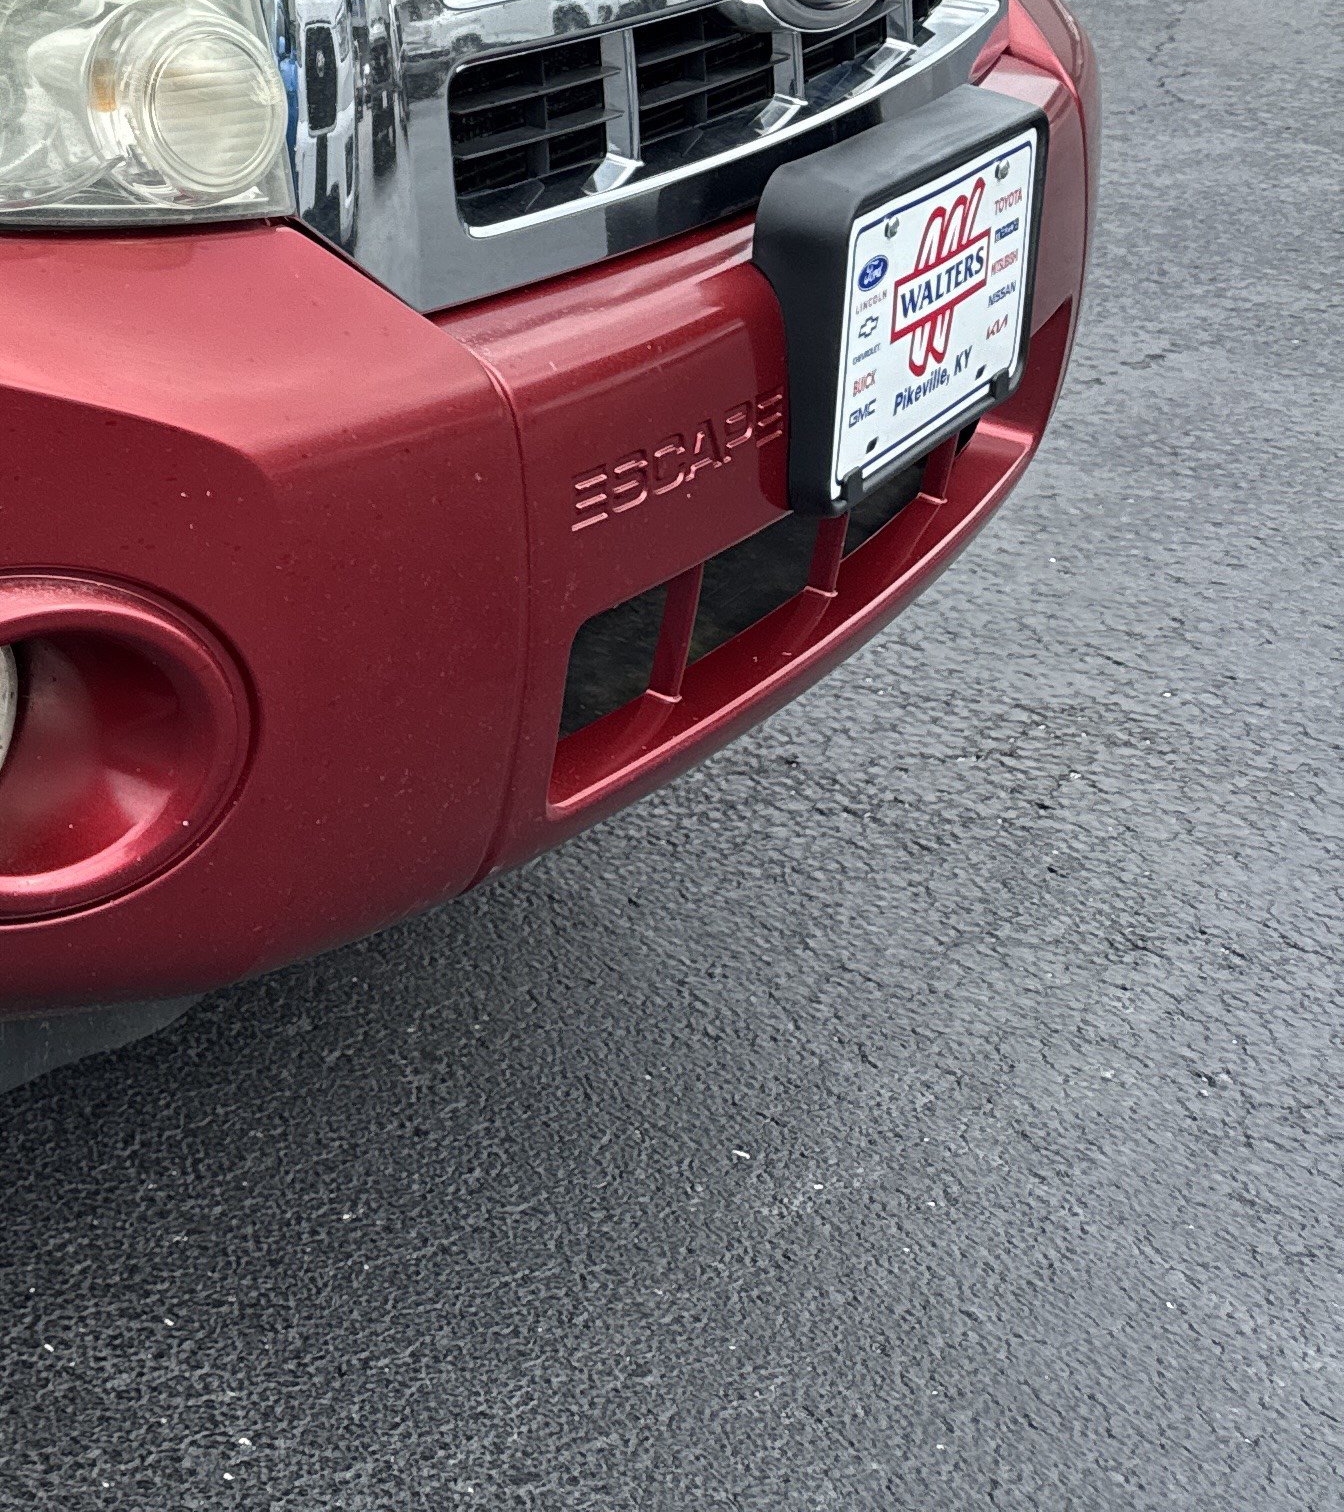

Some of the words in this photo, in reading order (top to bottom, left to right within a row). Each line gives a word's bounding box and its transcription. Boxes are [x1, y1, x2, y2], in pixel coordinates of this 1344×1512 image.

[994, 187, 1023, 216] TOYOTA
[863, 259, 884, 286] Ford
[900, 245, 985, 319] WALTERS
[987, 279, 1017, 309] NISSAN
[852, 368, 878, 398] BUICK
[893, 365, 950, 417] Pikeville,
[954, 345, 973, 377] KY
[848, 398, 877, 429] GMC
[571, 384, 784, 532] ESCAPE
